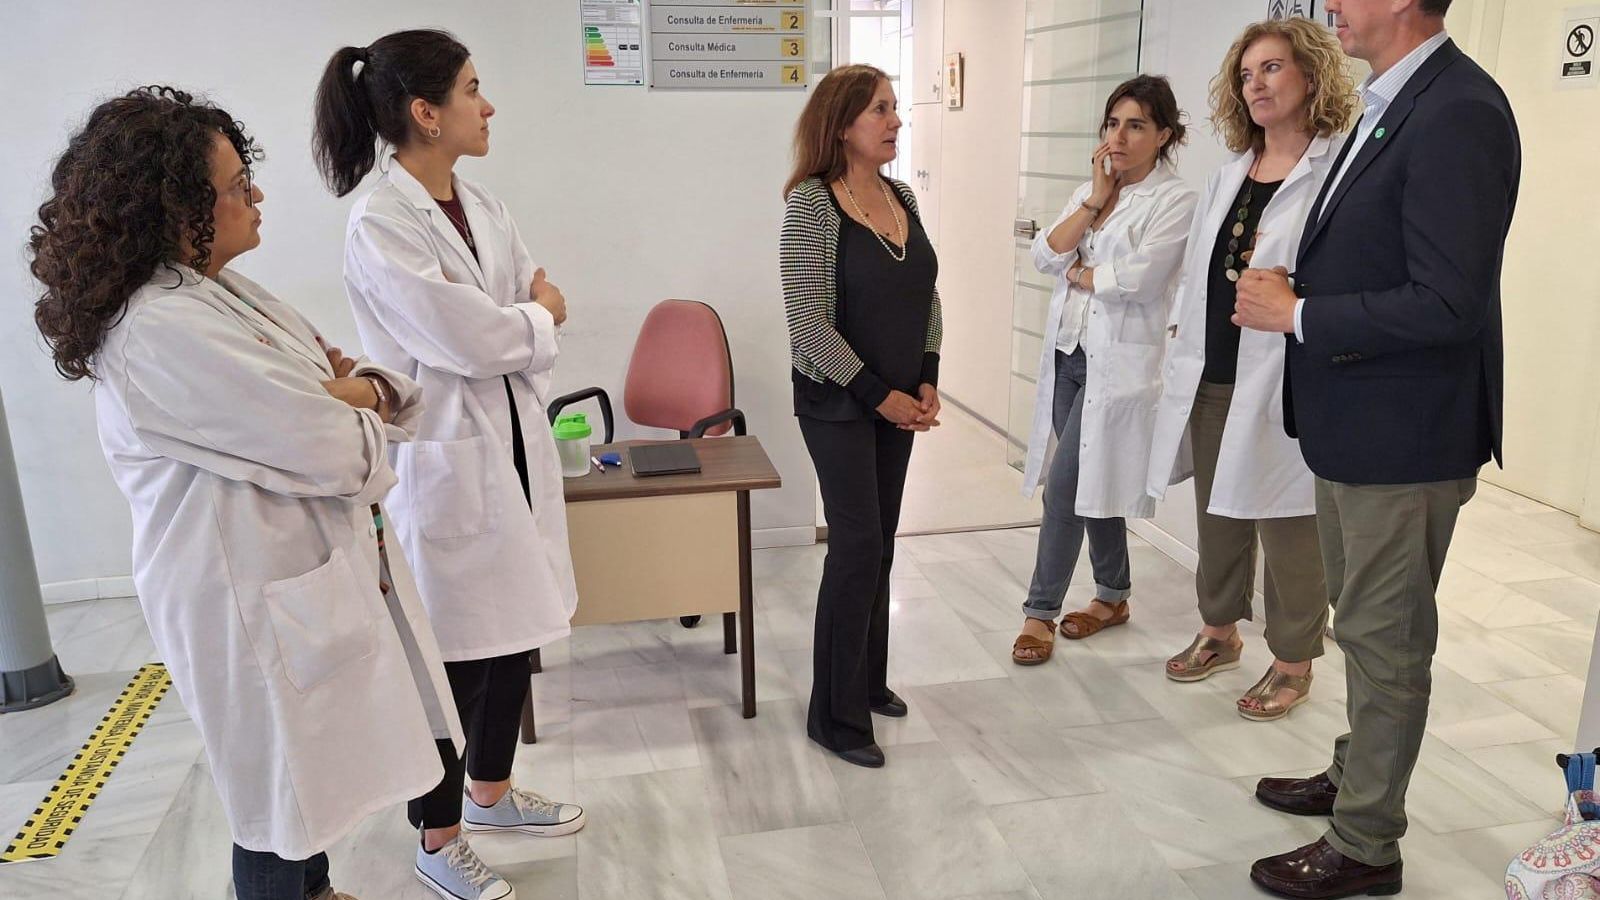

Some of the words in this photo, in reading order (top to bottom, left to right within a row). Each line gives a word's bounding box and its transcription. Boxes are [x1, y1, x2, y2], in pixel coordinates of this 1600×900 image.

[667, 15, 705, 25] Consulta
[706, 15, 716, 25] de
[790, 15, 799, 30] 2
[668, 42, 704, 52] Consulta
[707, 41, 736, 52] Médica
[790, 42, 799, 56] 3
[669, 69, 705, 79] Consulta
[708, 69, 718, 79] de
[790, 69, 799, 83] 4
[105, 701, 145, 738] MANTENGA
[99, 738, 120, 748] LA
[70, 748, 112, 787] DISTANCIA
[61, 788, 85, 799] DE
[26, 800, 76, 849] SEGURIDAD
